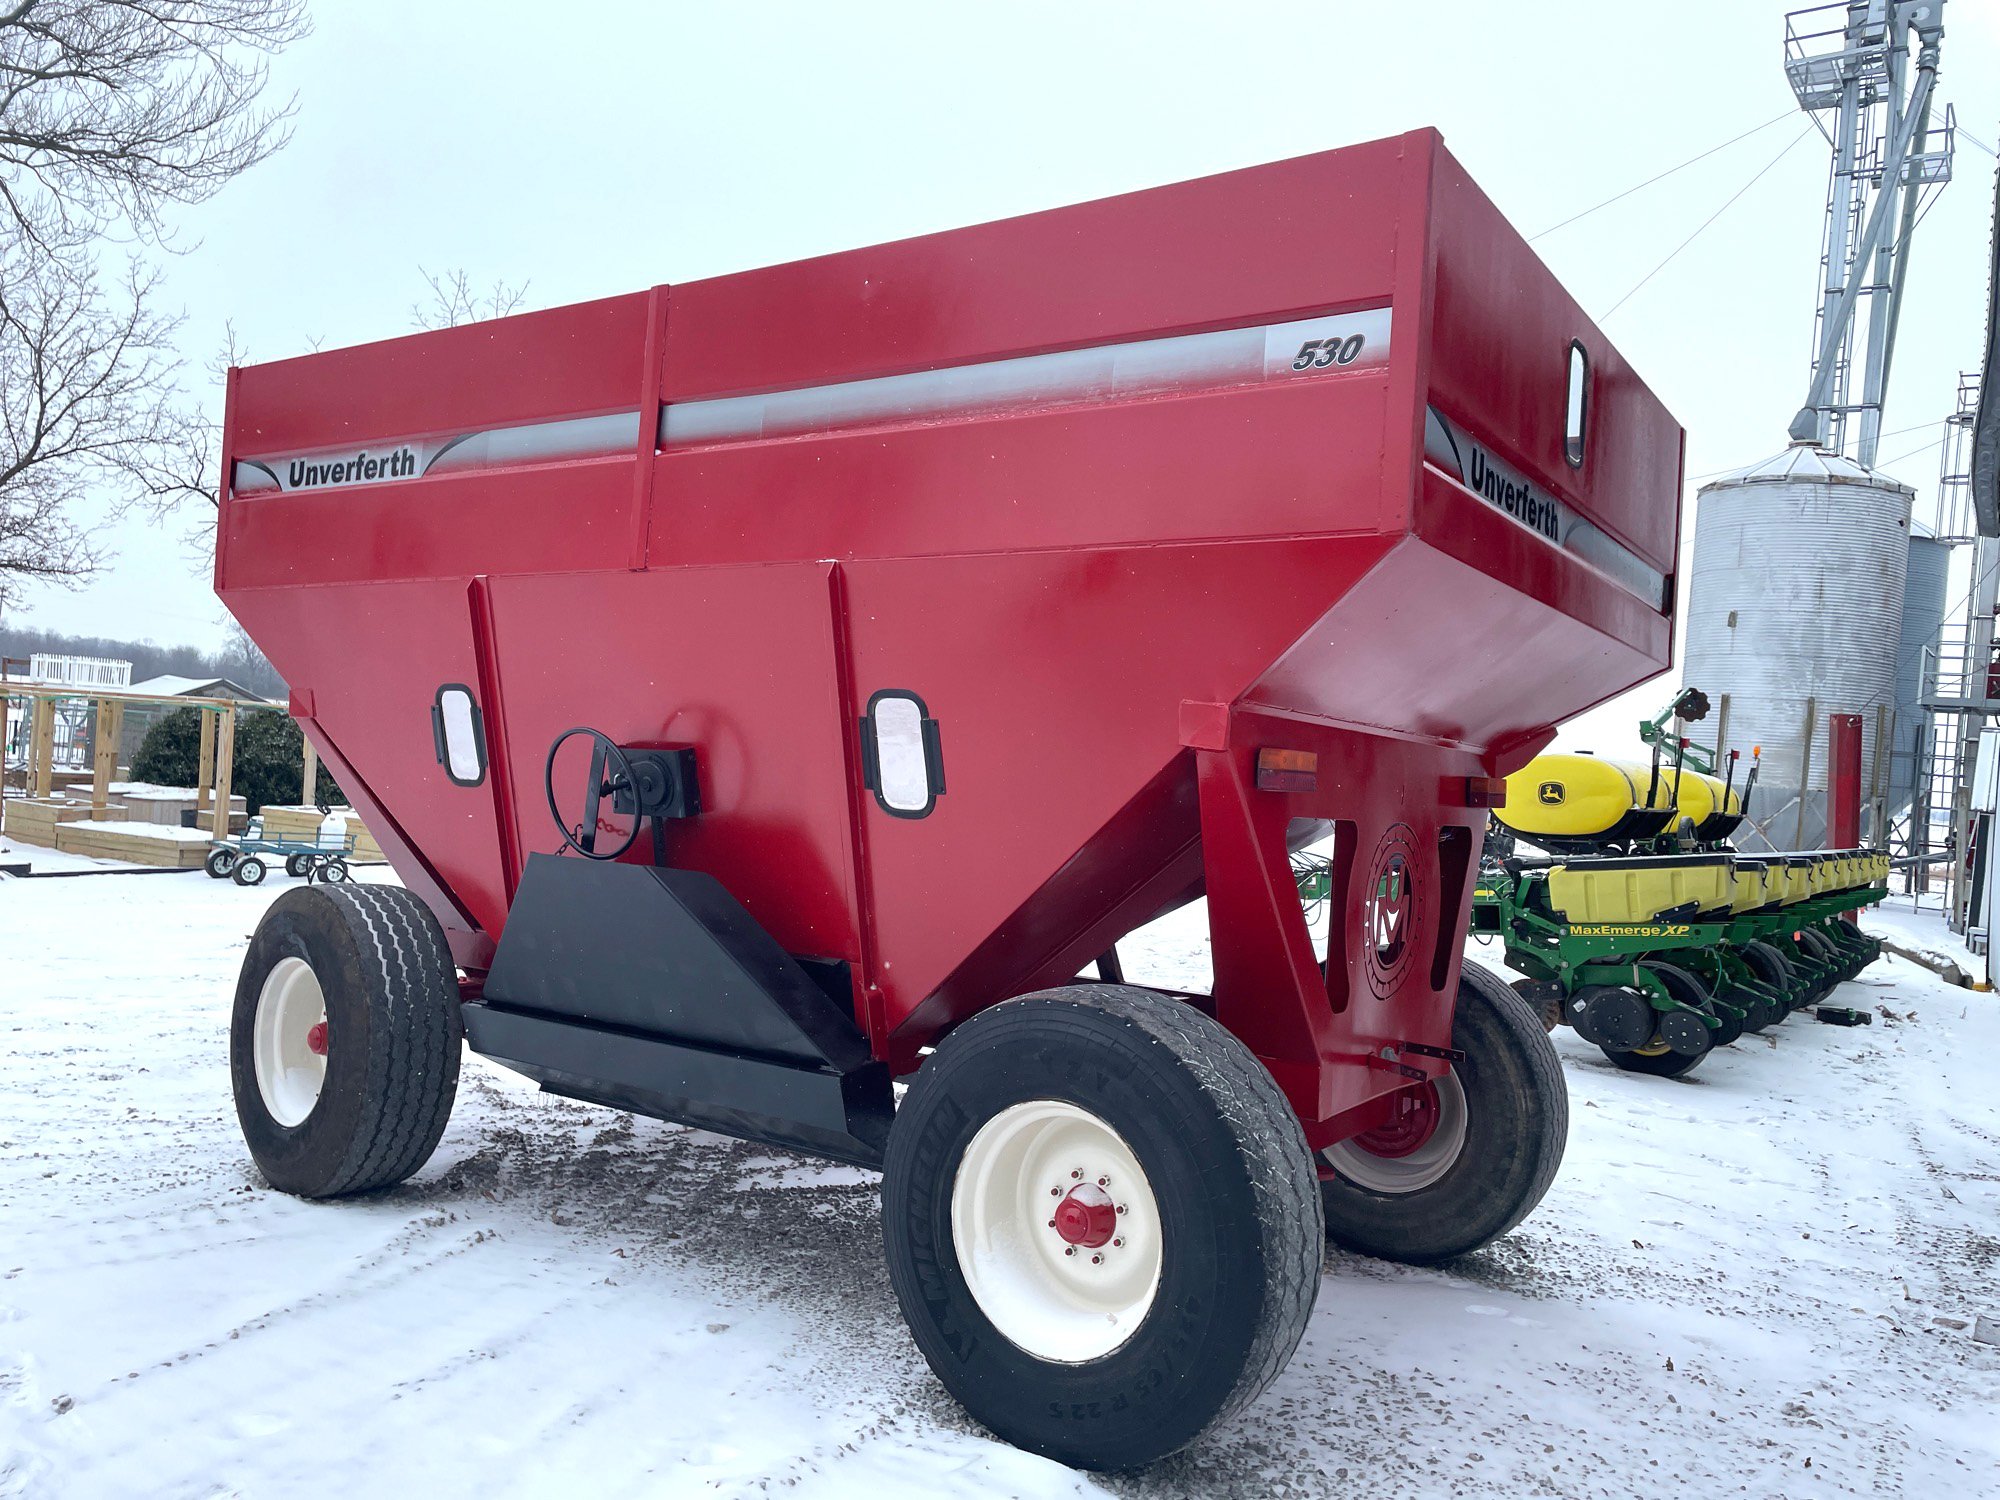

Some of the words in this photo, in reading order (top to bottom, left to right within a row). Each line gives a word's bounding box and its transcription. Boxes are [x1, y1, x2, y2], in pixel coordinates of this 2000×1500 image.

[1291, 333, 1365, 371] 530
[289, 448, 415, 488] Unverferth
[1470, 447, 1559, 542] Unverferth
[1569, 925, 1660, 936] MaxEmerge
[1661, 925, 1690, 936] XP
